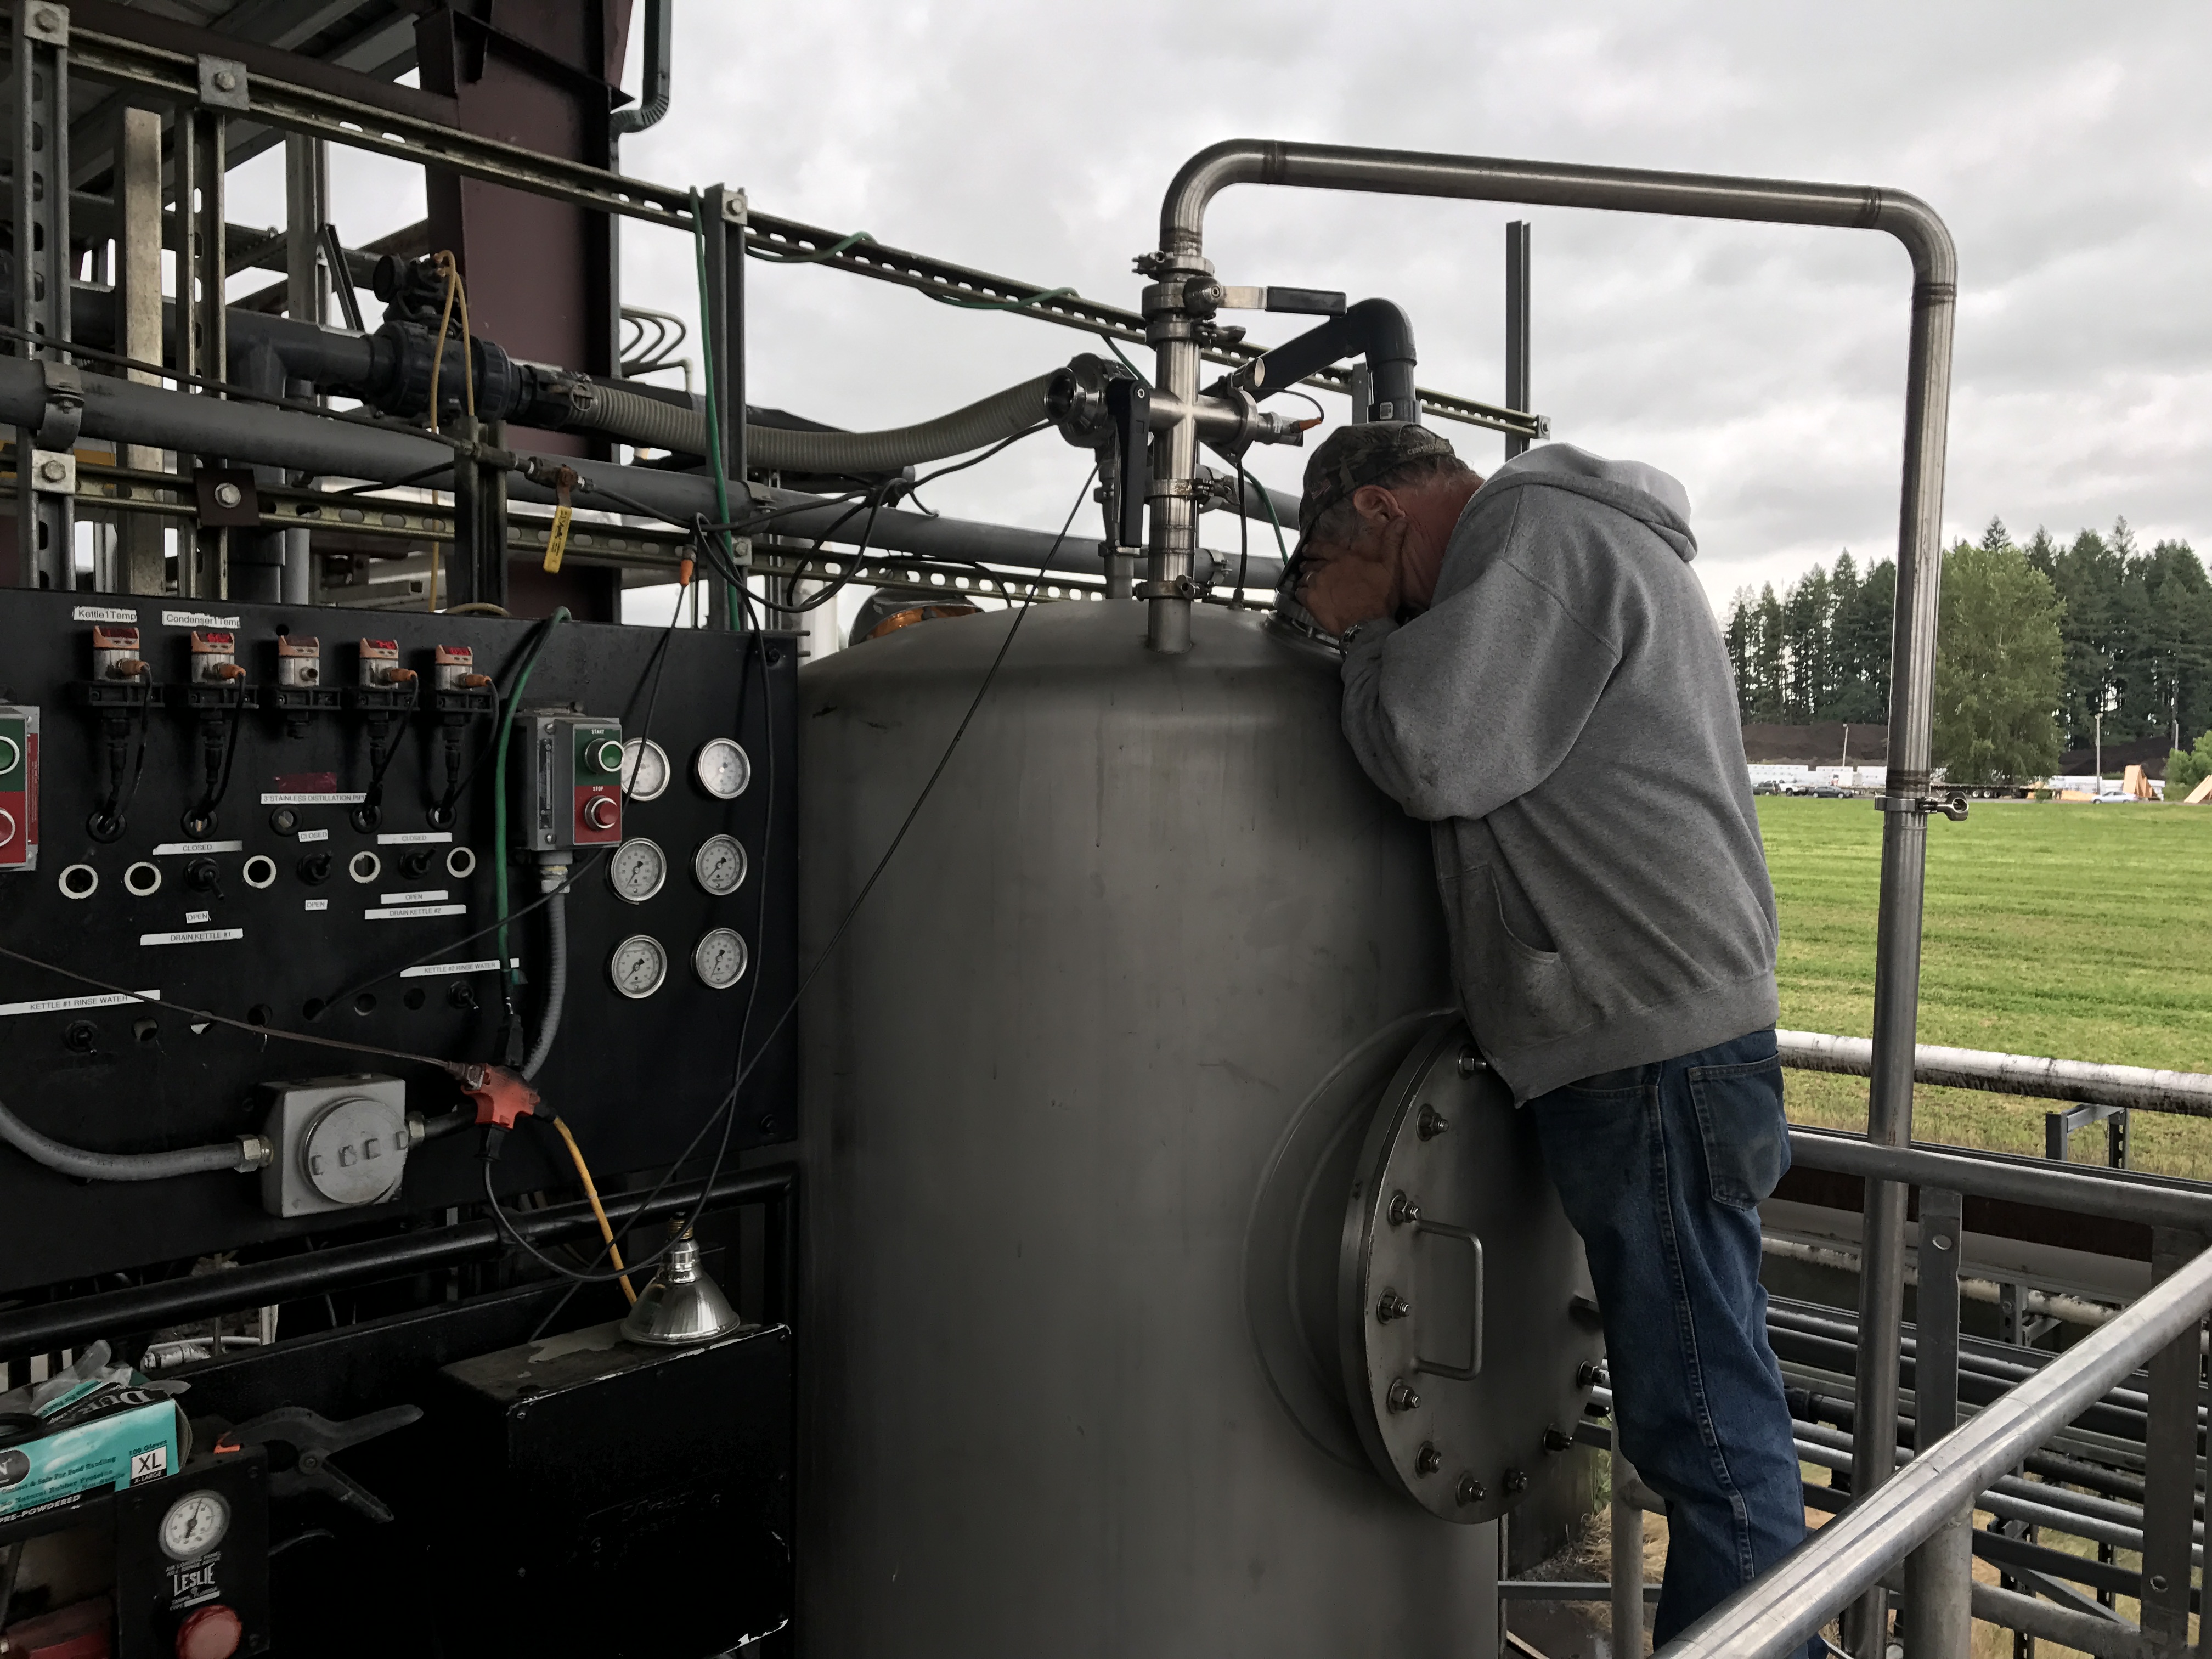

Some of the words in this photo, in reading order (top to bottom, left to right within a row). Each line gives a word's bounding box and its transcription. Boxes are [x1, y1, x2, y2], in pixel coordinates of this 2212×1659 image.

[300, 832, 328, 840] CLOSED
[195, 932, 221, 940] KETTLE
[30, 1002, 60, 1011] KETTLE
[74, 998, 98, 1006] RINSE
[100, 995, 128, 1004] WATER
[129, 1447, 142, 1456] 100
[144, 1440, 167, 1451] Gloves
[68, 1465, 84, 1476] Food
[86, 1456, 116, 1470] Handling
[138, 1452, 162, 1474] XL
[134, 1470, 162, 1484] X-LARGE
[173, 1562, 216, 1597] LESLIE
